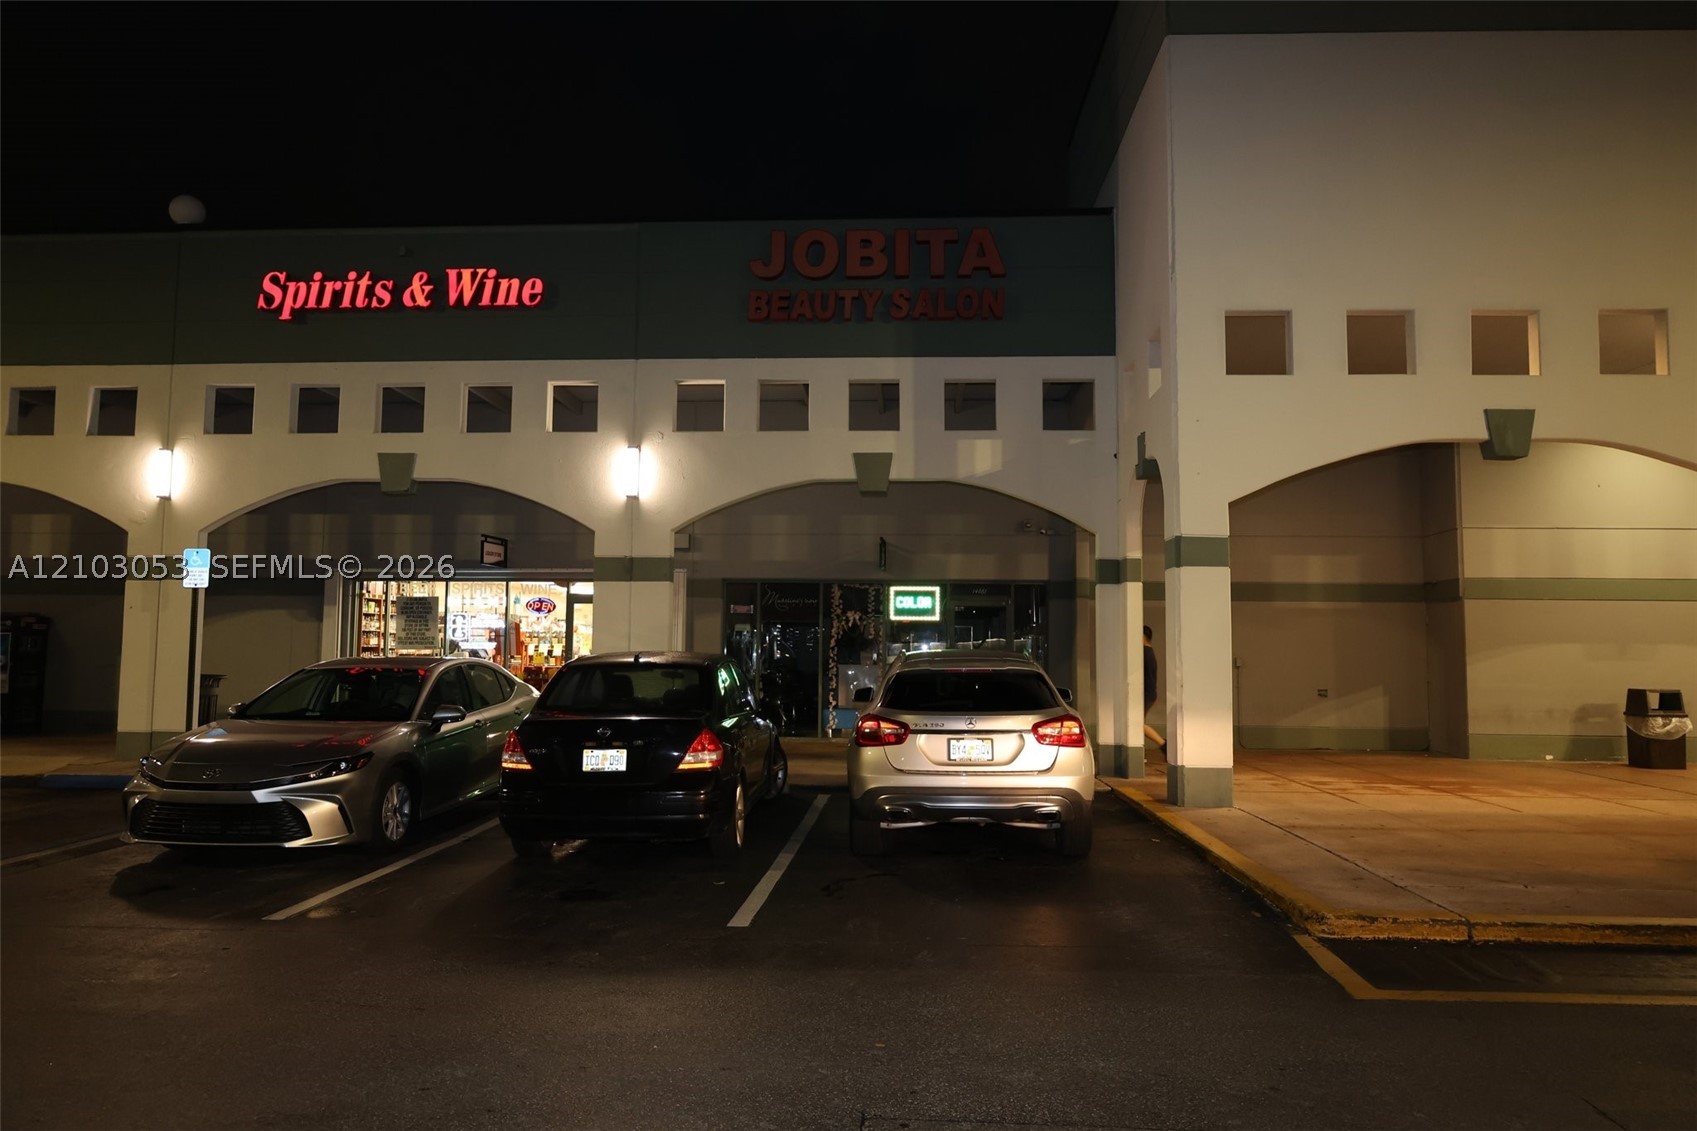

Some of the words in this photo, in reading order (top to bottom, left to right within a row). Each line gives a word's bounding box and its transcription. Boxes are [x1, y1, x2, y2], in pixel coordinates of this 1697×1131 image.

[750, 227, 1006, 281] JOBITA
[256, 271, 394, 320] Spirits
[402, 270, 434, 308] &
[446, 268, 545, 307] Wine
[748, 287, 884, 321] BEAUTY
[889, 286, 1006, 321] SALON
[452, 582, 505, 595] SPIRITS
[520, 582, 558, 595] WINE
[527, 601, 554, 611] OPEN
